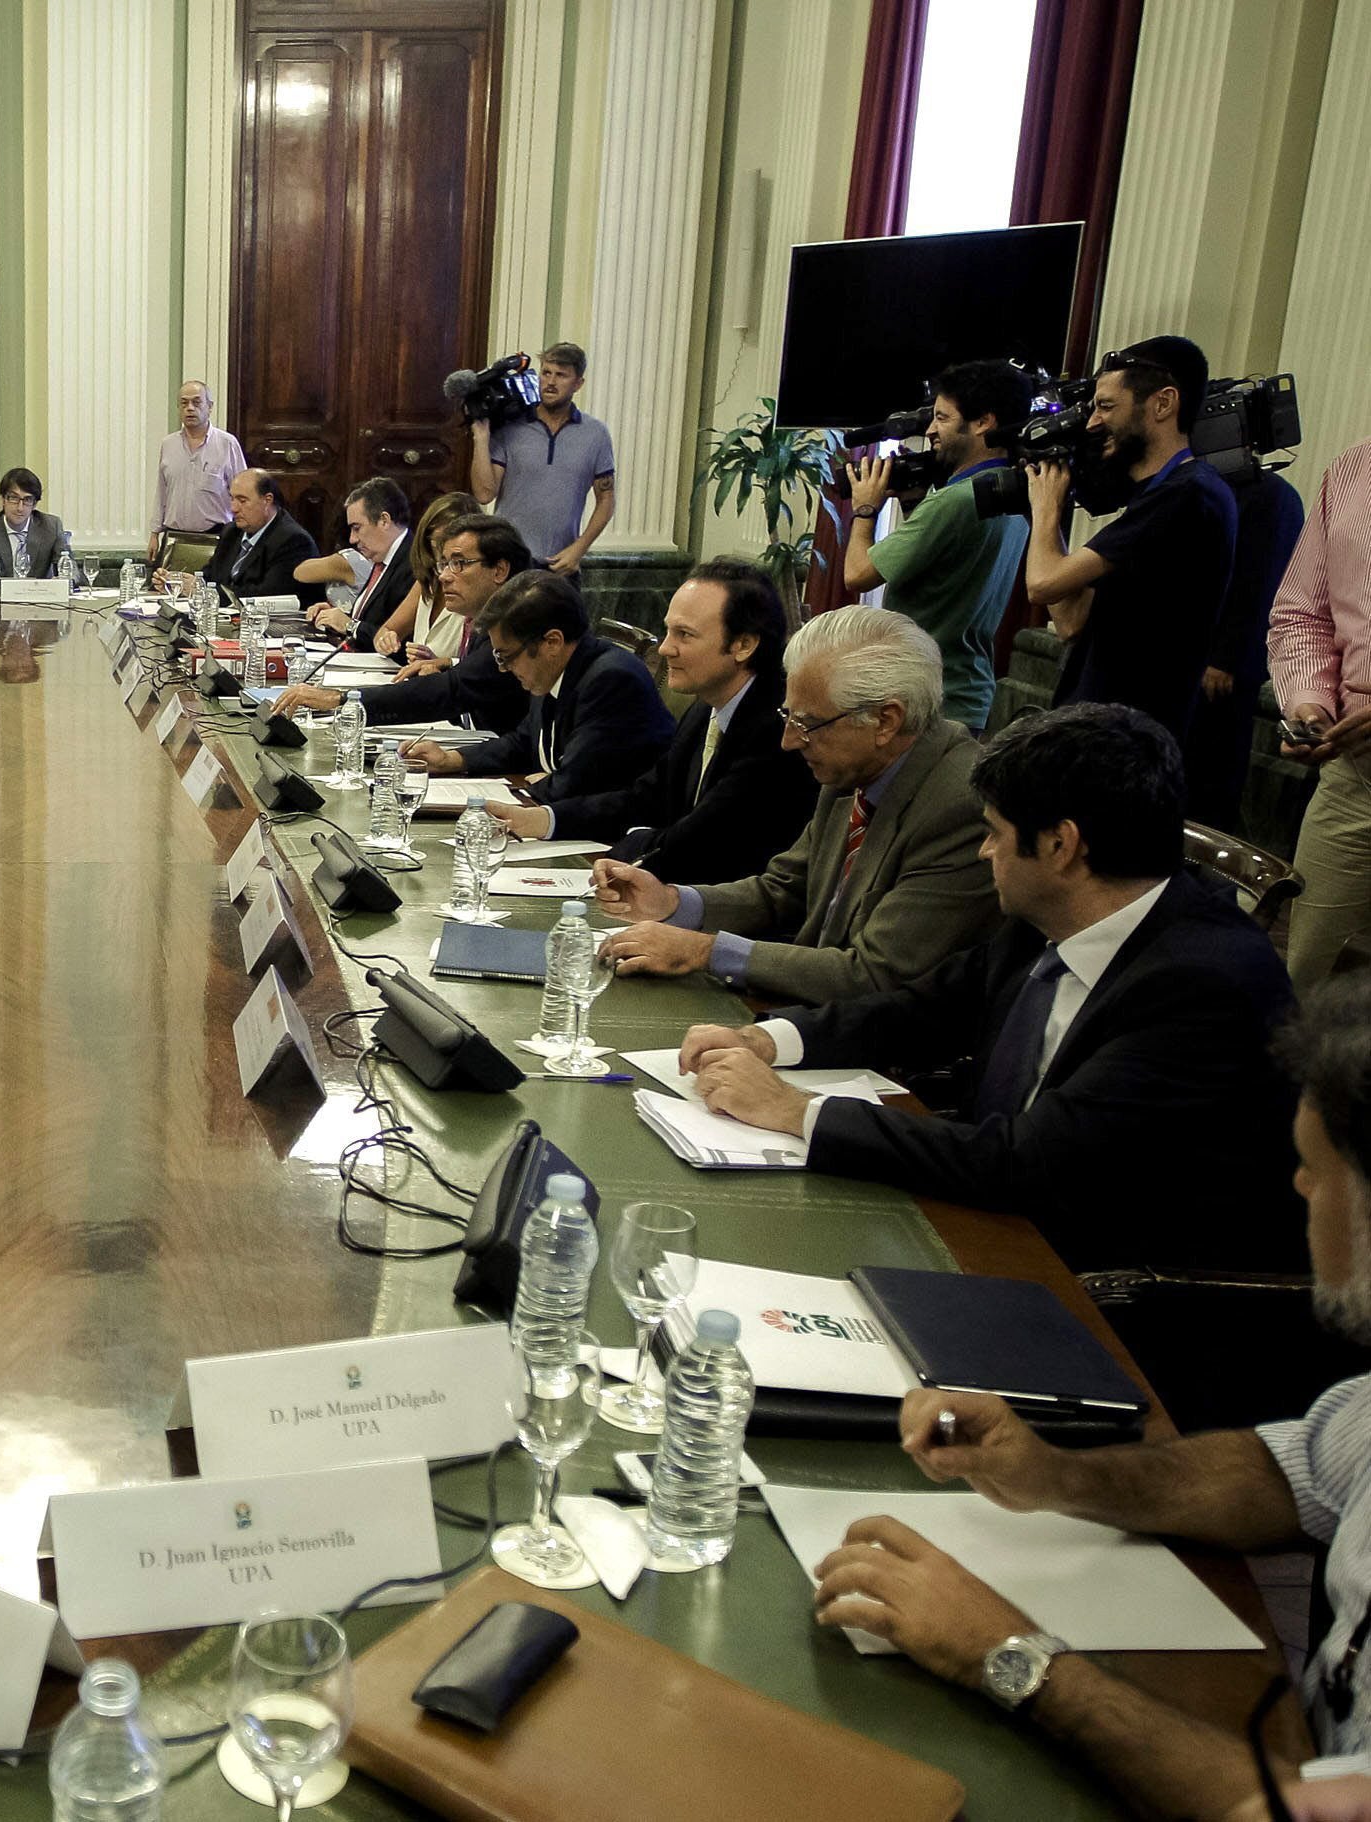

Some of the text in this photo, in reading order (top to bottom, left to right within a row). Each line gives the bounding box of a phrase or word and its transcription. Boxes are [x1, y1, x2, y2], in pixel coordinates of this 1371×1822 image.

[269, 1390, 447, 1426] D. José Manuel Delgado
[342, 1420, 381, 1438] UPA
[139, 1529, 356, 1570] D. Juan Ignacio Senovilla
[228, 1564, 274, 1585] UPA
